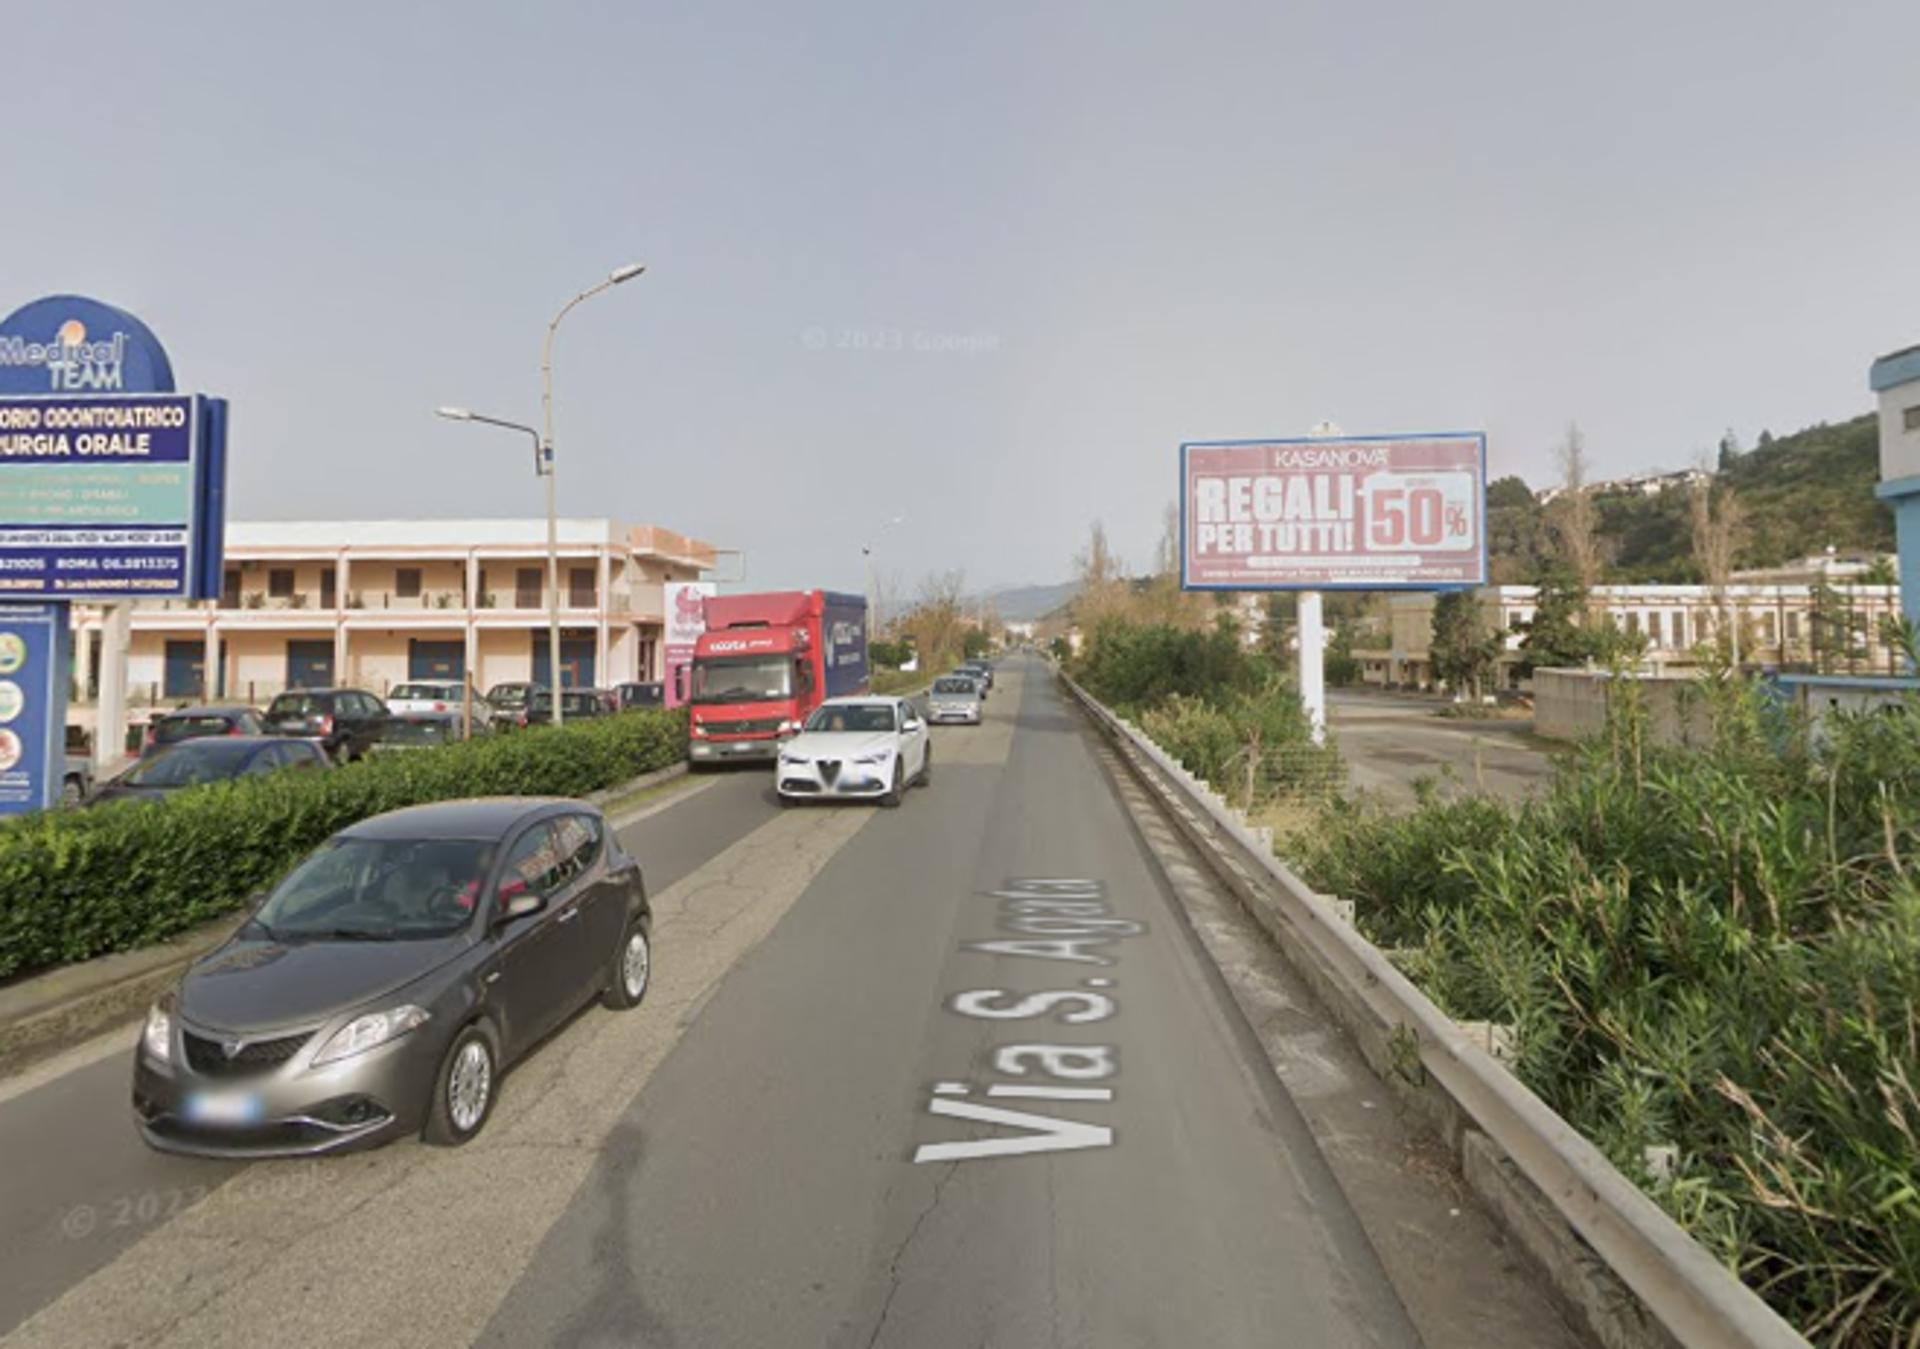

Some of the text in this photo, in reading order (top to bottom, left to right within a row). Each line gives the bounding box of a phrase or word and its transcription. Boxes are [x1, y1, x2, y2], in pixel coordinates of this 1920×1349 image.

[48, 361, 123, 390] TEAM
[43, 405, 185, 430] ODONTOIATRICO
[74, 432, 151, 455] ORALE
[1197, 475, 1355, 522] REGALI
[1196, 522, 1253, 554] PER
